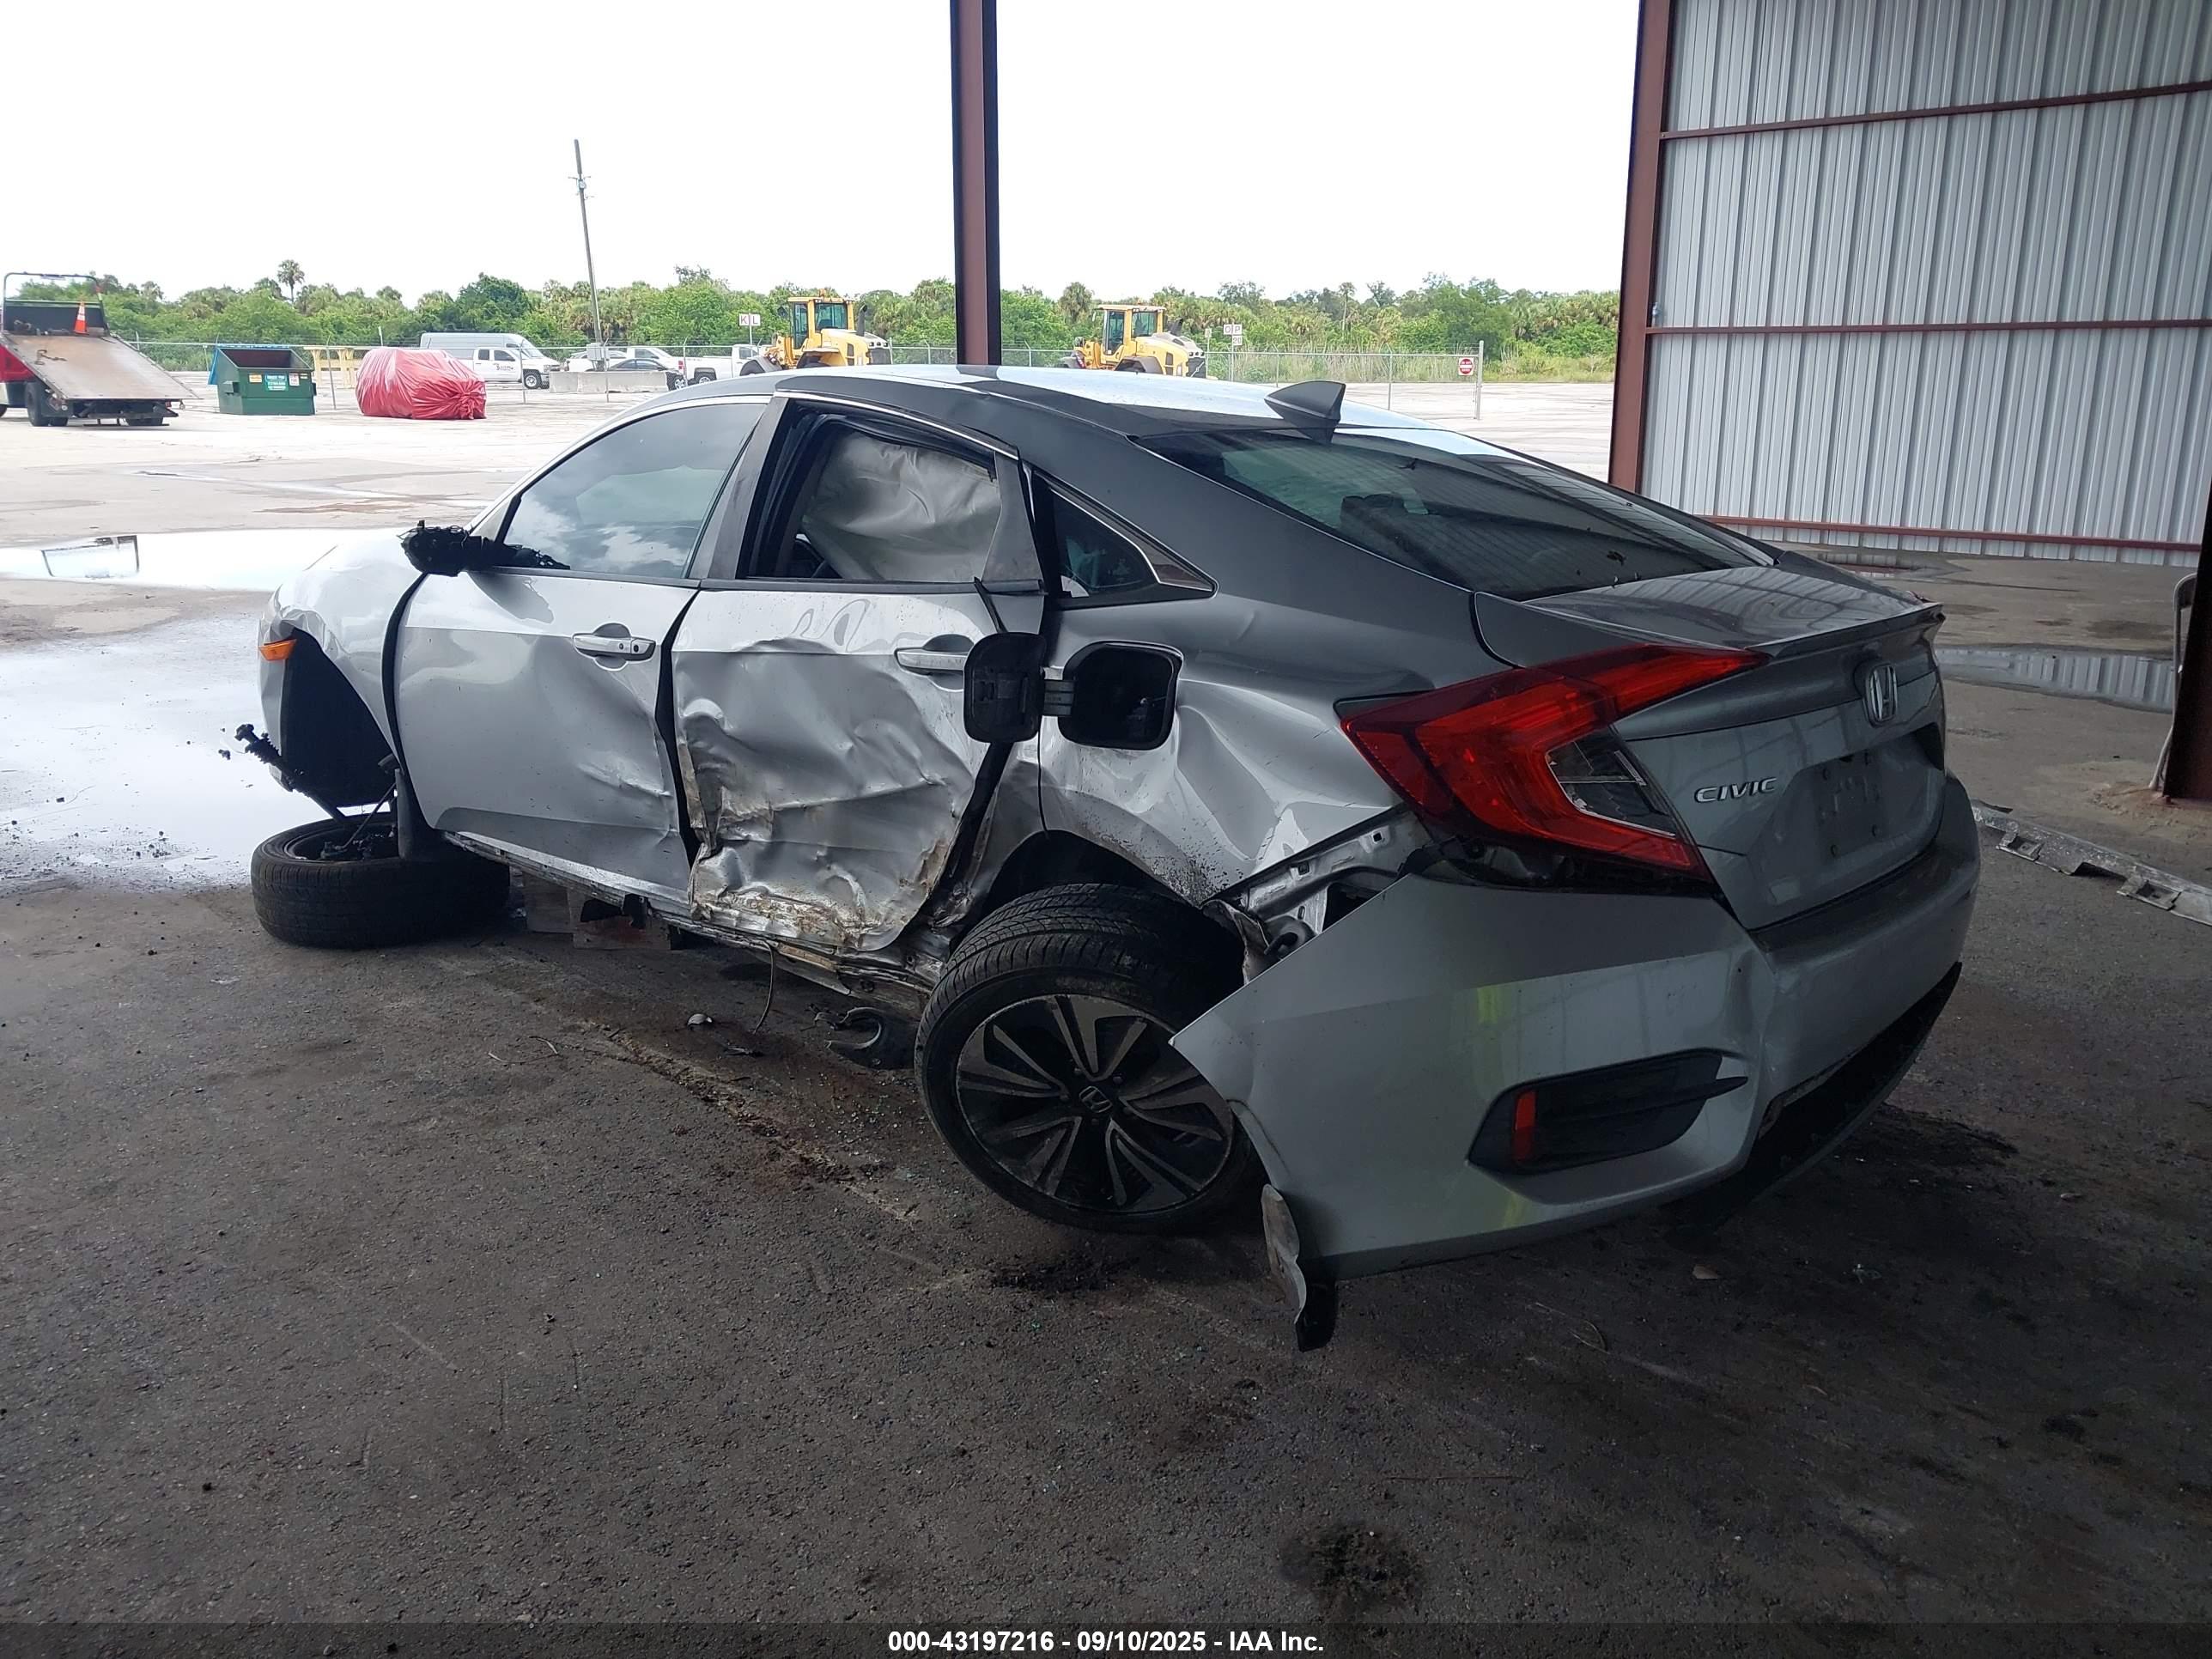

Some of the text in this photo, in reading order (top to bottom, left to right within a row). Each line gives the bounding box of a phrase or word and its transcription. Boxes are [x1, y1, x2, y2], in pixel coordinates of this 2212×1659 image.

[741, 315, 758, 325] K L
[1694, 776, 1778, 804] CIVIC
